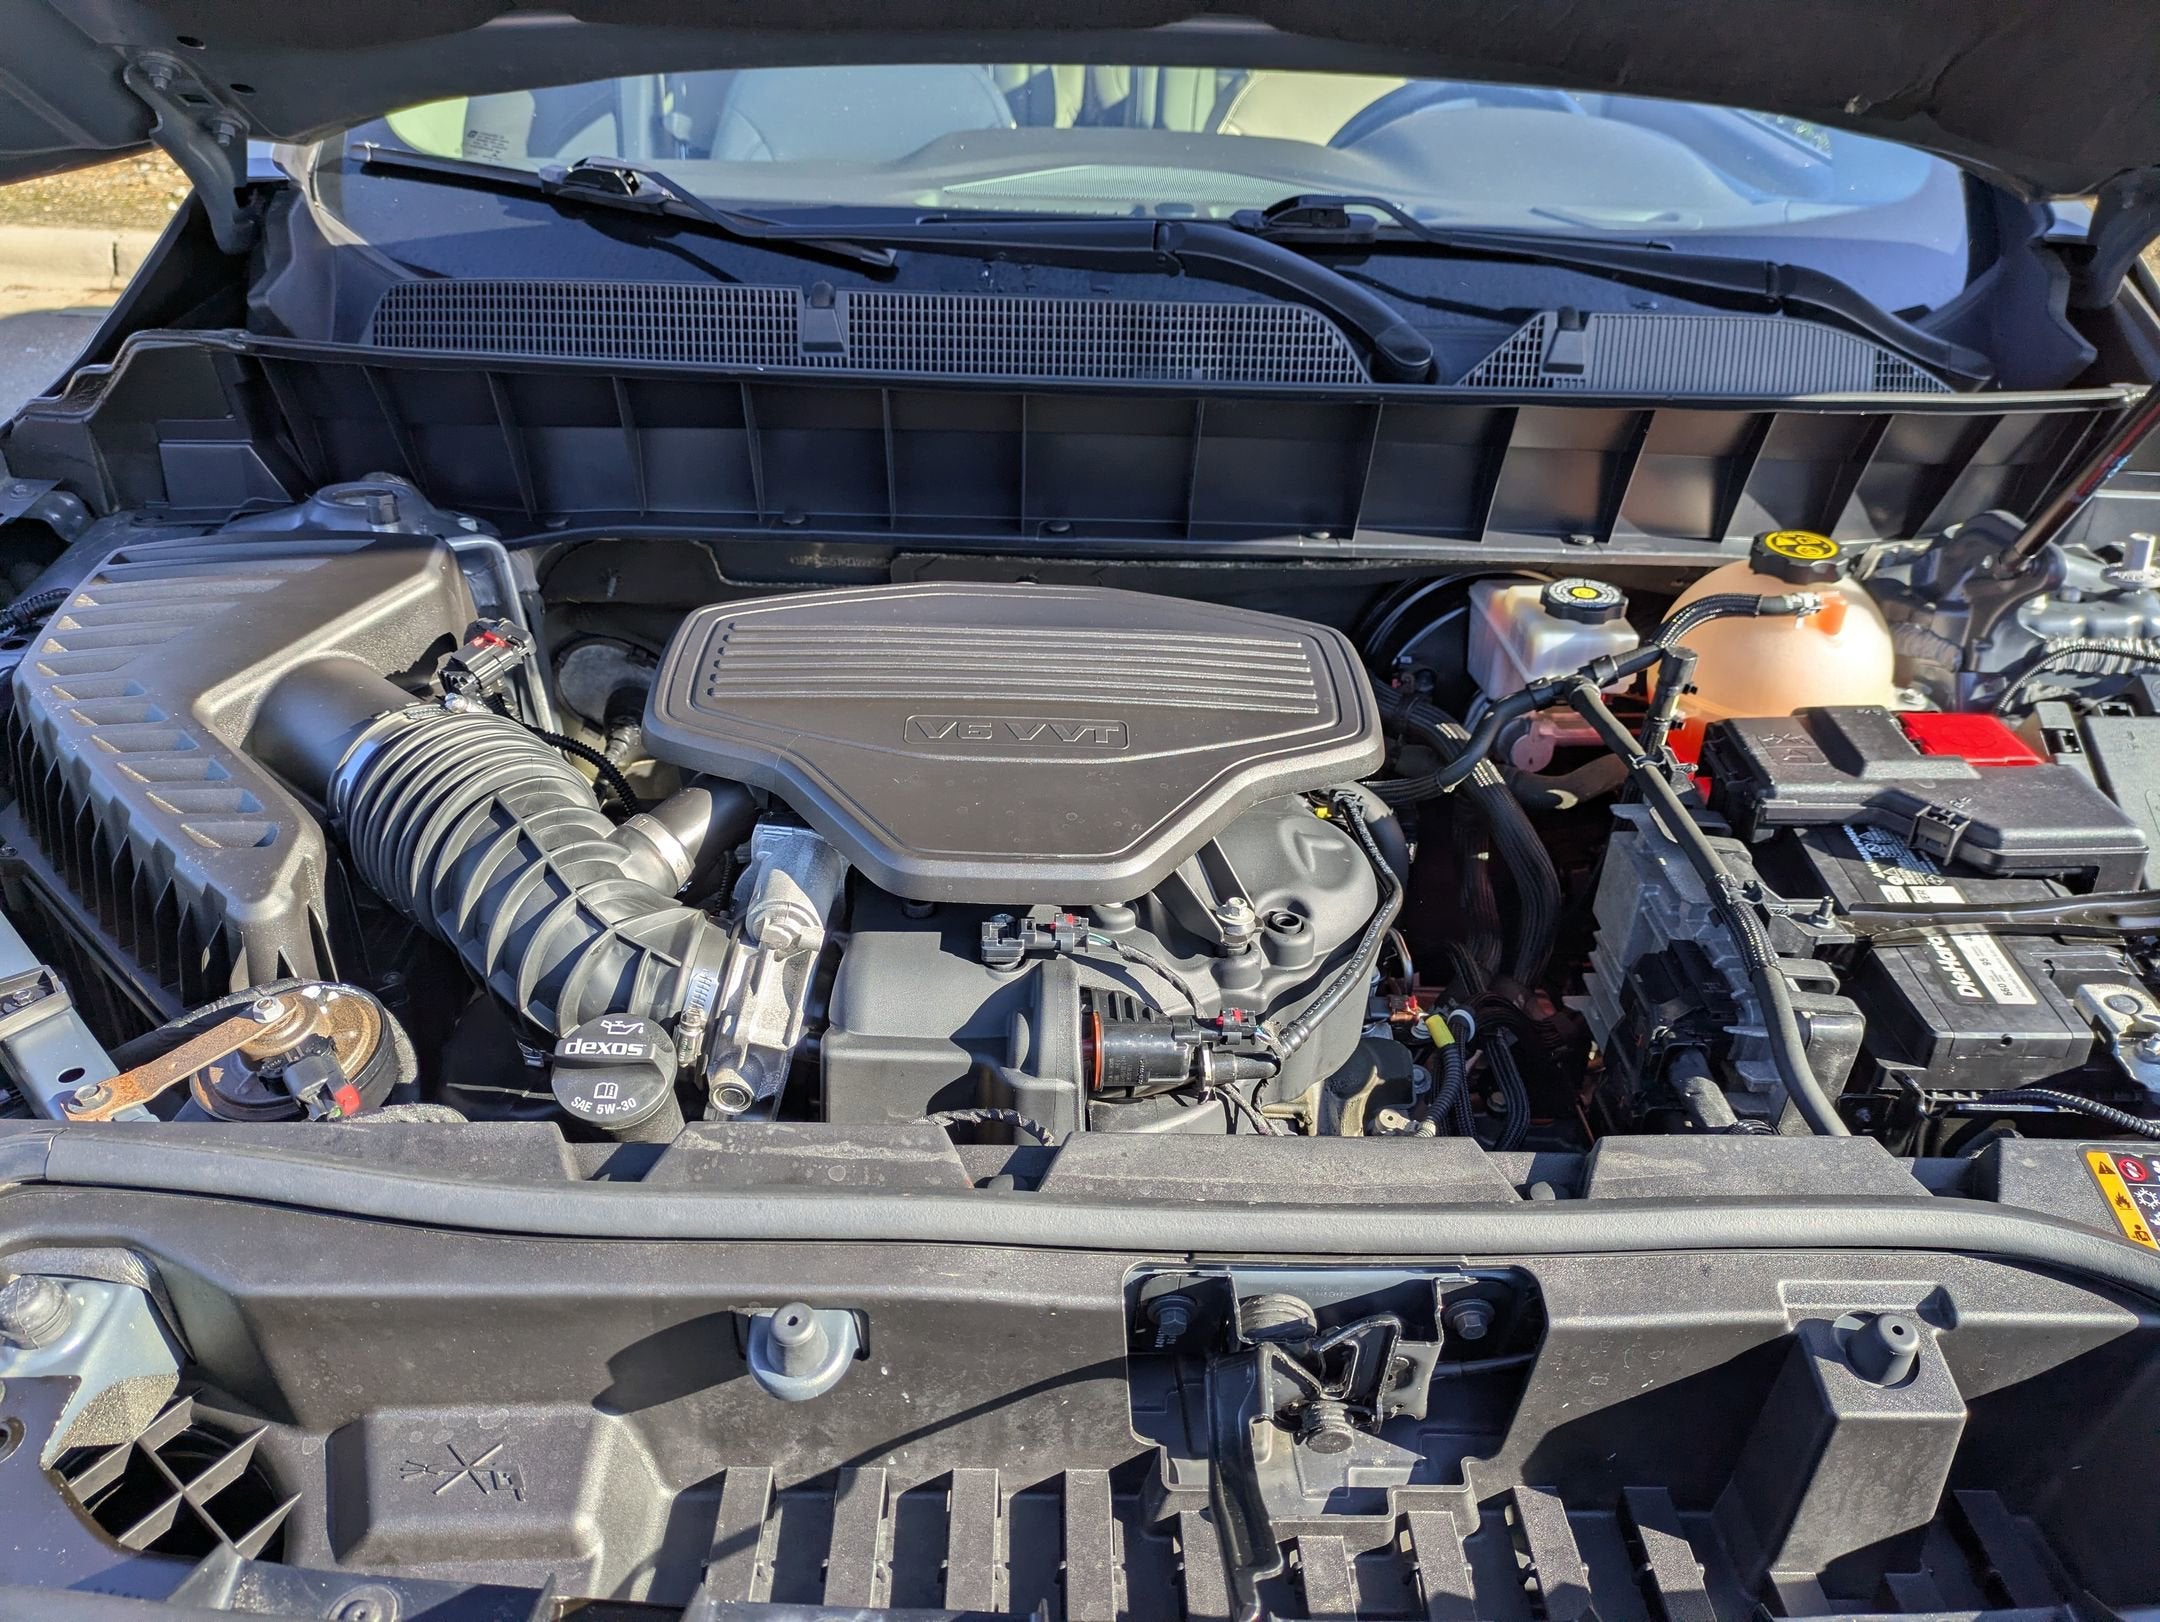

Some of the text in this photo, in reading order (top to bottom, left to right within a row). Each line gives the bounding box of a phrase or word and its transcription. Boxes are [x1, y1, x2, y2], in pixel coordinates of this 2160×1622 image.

[915, 721, 1120, 744] V6 VVT
[1926, 936, 1983, 998] DieHard
[564, 1038, 646, 1056] dexos
[571, 1096, 637, 1115] SAE 5W-30
